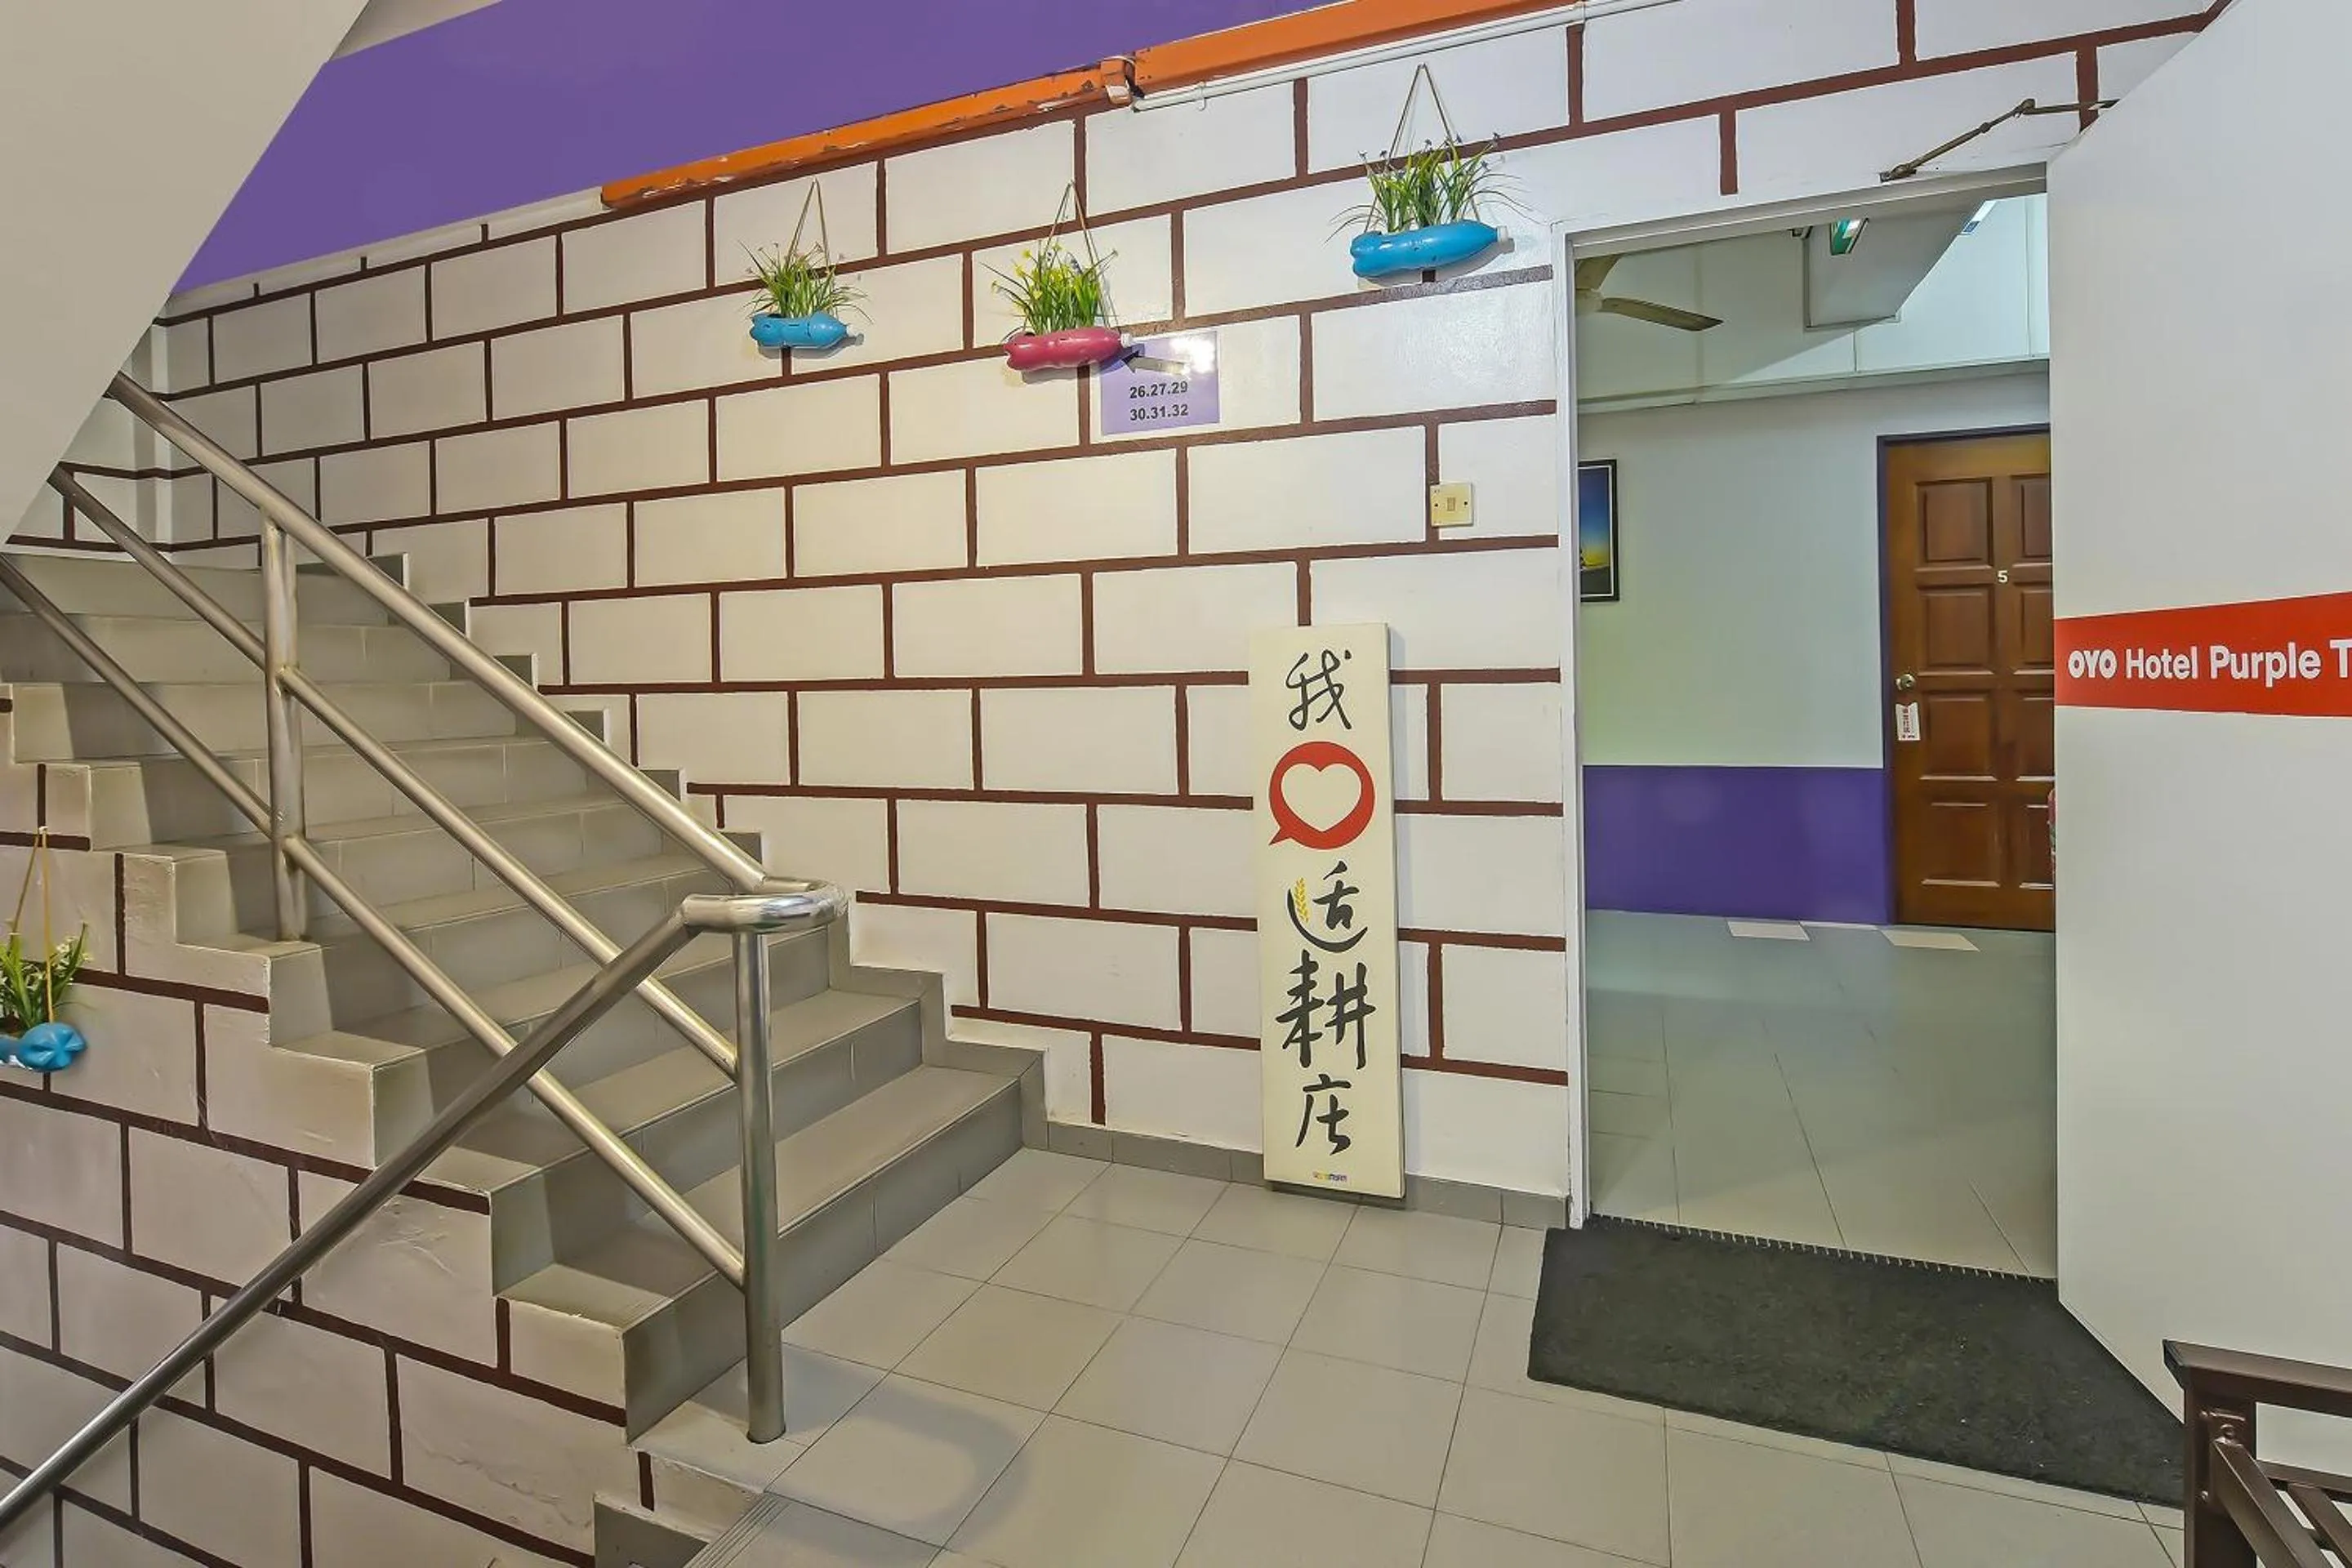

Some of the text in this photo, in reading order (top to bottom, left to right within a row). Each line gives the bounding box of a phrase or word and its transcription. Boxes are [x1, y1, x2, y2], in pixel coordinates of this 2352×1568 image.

[1129, 381, 1188, 399] 26.27.29
[1129, 403, 1188, 421] 30.31.32
[1997, 570, 2009, 583] 5
[2068, 648, 2118, 679] OYO
[2126, 645, 2198, 679] Hotel
[2209, 642, 2321, 688] Purple
[1287, 650, 1352, 730] 我
